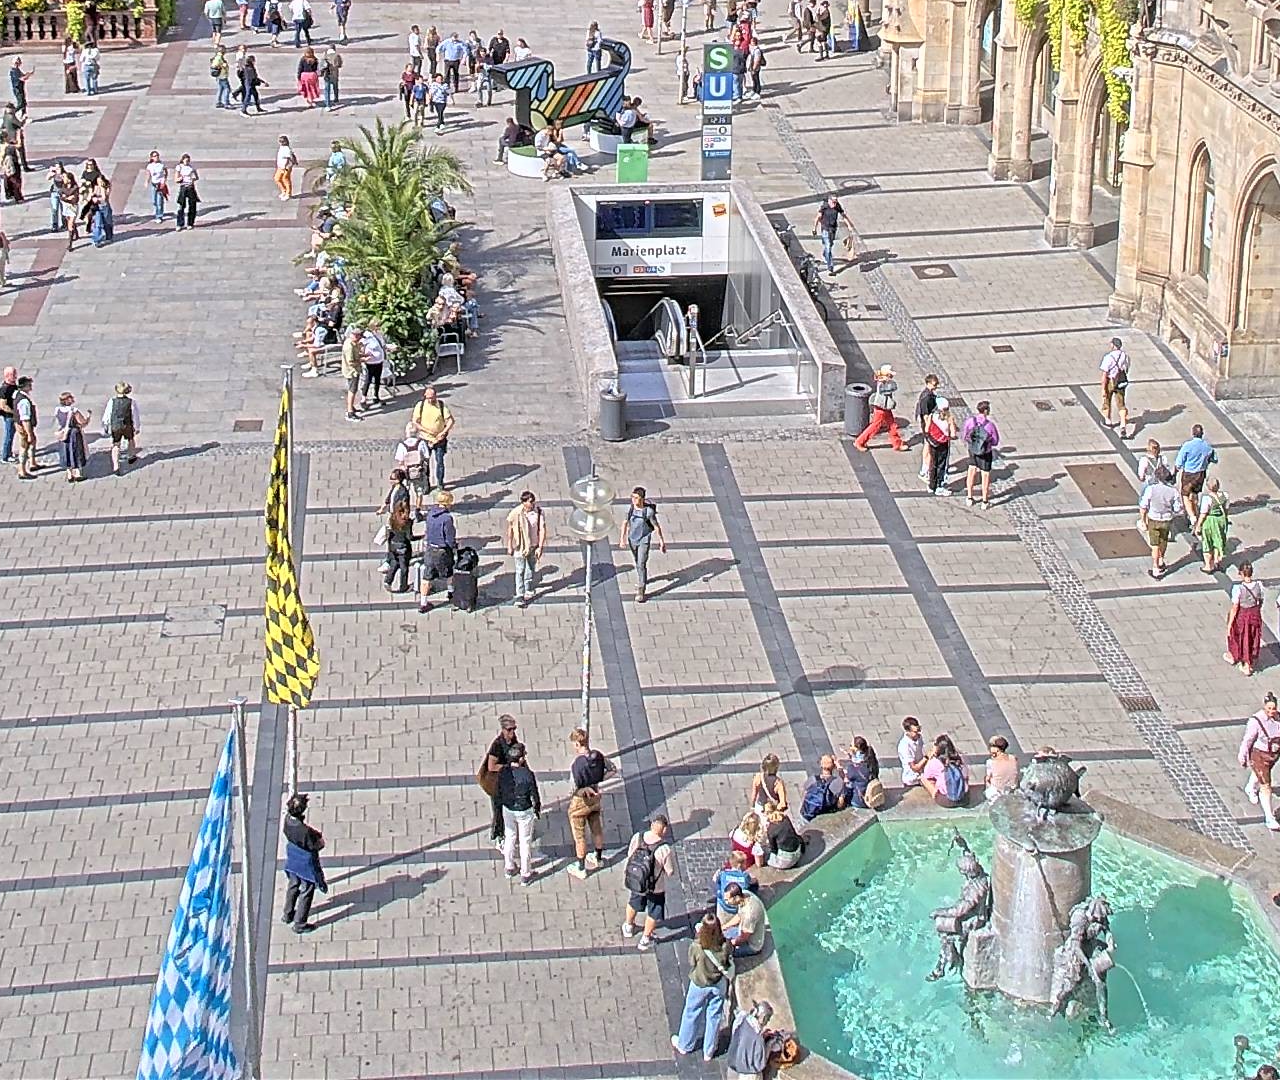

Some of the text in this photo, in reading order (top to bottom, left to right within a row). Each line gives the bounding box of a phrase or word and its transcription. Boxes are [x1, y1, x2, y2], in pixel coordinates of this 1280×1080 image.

[709, 47, 729, 70] S
[709, 76, 726, 97] U
[611, 244, 687, 258] Marienplatz
